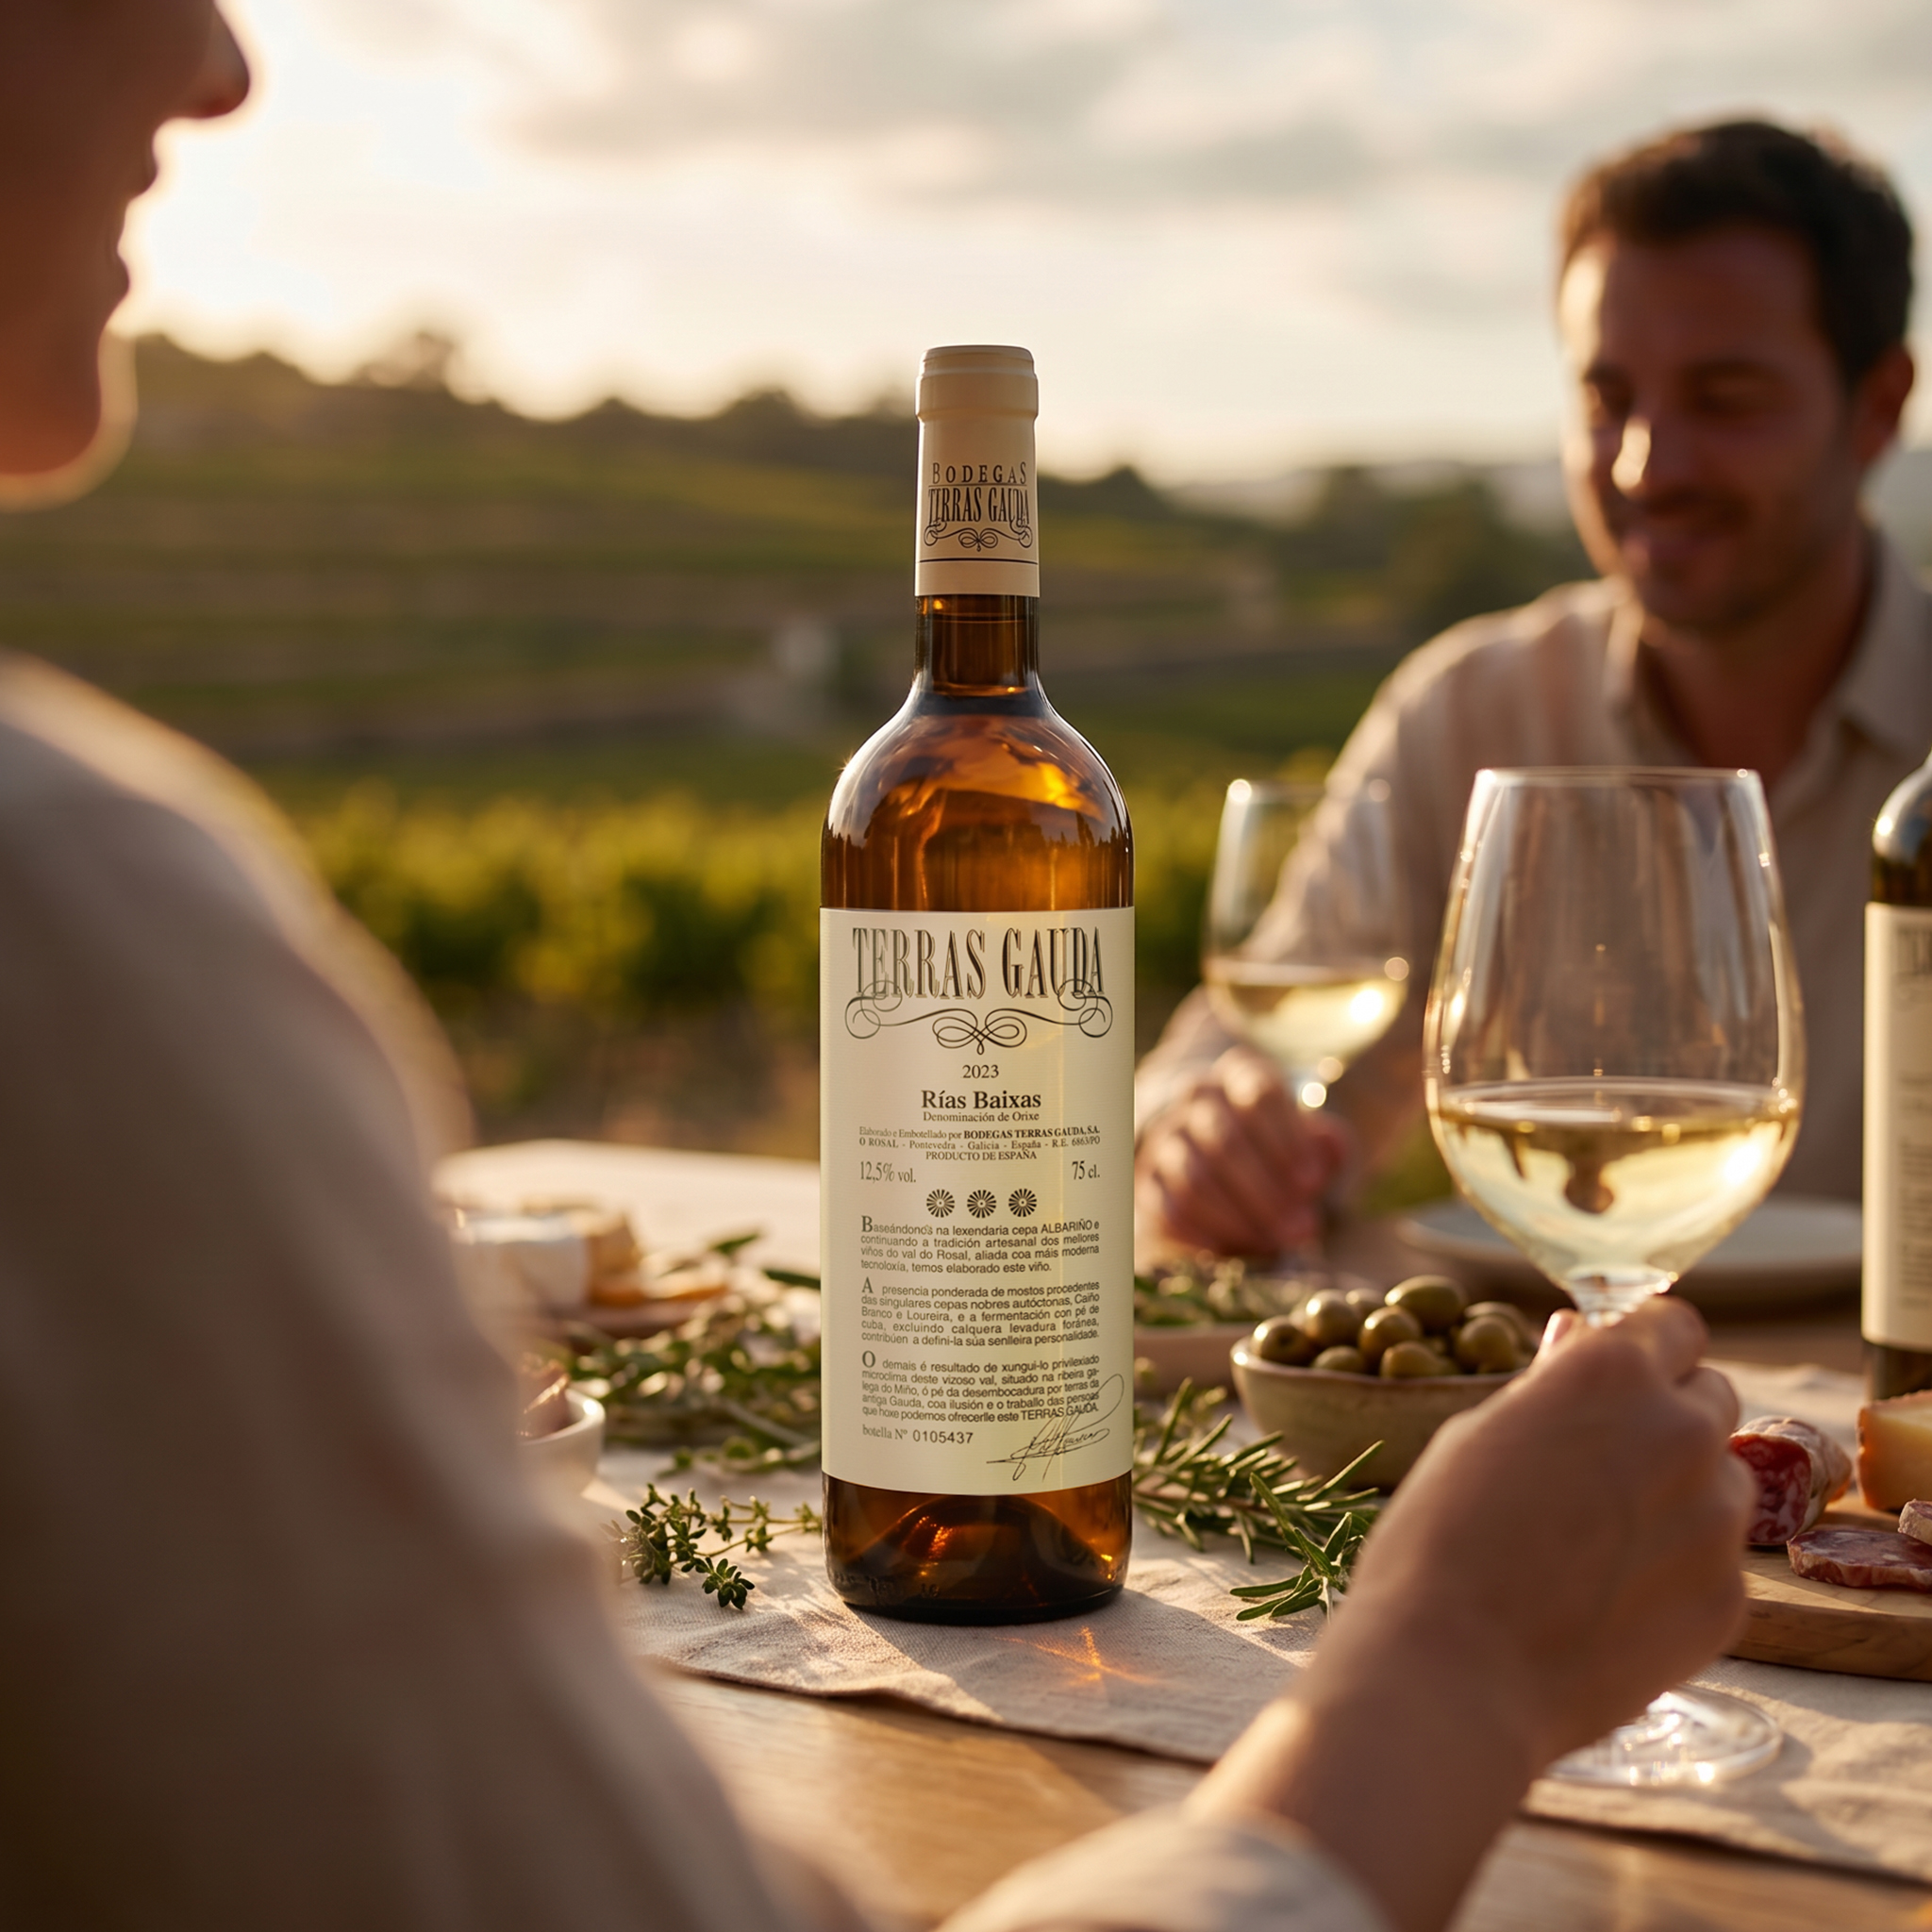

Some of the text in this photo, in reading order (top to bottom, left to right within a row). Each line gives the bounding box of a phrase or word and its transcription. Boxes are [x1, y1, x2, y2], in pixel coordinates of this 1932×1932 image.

[932, 461, 1026, 484] BODEGAS
[988, 487, 1030, 525] GAUDA
[852, 925, 1105, 1000] TERRAS GAUDA
[962, 1064, 999, 1079] 2023
[921, 1090, 1041, 1108] Rías Baixas
[923, 1111, 1040, 1122] Denominación de Orixe
[859, 1126, 891, 1137] Elaborado
[898, 1129, 947, 1139] Embotellado
[948, 1132, 961, 1141] por
[963, 1130, 1013, 1139] BODEGAS
[1014, 1128, 1053, 1138] TERRAS
[859, 1137, 866, 1146] O
[868, 1138, 898, 1148] ROSAL
[909, 1140, 956, 1150] Pontevedra
[967, 1141, 999, 1150] Galicia
[1011, 1140, 1041, 1151] España
[1052, 1138, 1069, 1147] R.E.
[1072, 1135, 1101, 1147] 6863/PO
[925, 1148, 1037, 1160] PRODUCTO DE ESPAÑA
[860, 1160, 917, 1183] 12,5% vol.
[1072, 1160, 1100, 1180] 75 cl.
[936, 1227, 949, 1236] na
[953, 1225, 1008, 1236] lexendaria
[1011, 1226, 1038, 1237] cepa
[1041, 1219, 1092, 1234] ALBARIÑO
[1093, 1221, 1100, 1229] e
[860, 1233, 1100, 1248] continuando a tradición artesanal dos mellores
[860, 1245, 1100, 1261] viños do val do Rosal, aliada coa máis moderna
[860, 1259, 1052, 1274] tecnoloxía, temos elaborado este viño.
[861, 1275, 1100, 1299] A presencia ponderada de mostos procedentes
[861, 1292, 1100, 1311] das singulares cepas nobres autóctonas, Caiño
[861, 1305, 1100, 1323] Branco e Loureira, e a fermentación con pé de
[861, 1318, 1100, 1336] cuba, excluindo calquera levadura foránea,
[861, 1329, 1100, 1346] contribúen a defini-la súa senlleira personalidade.
[861, 1350, 1100, 1374] O demais é resultado de xungui-lo privilexiado
[861, 1368, 1100, 1386] microclima deste vizoso val, situado na ribeira ga-
[861, 1378, 1100, 1398] lega do Miño, ó pé da desembocadura por terras da
[861, 1391, 1100, 1410] antiga Gauda, coa ilusión e o traballo das persoas
[861, 1407, 878, 1417] que
[878, 1407, 899, 1419] hoxe
[901, 1409, 946, 1422] podemos
[947, 1411, 995, 1423] ofrecerlle
[997, 1411, 1020, 1422] este
[1021, 1407, 1065, 1421] TERRAS
[862, 1424, 892, 1440] botella
[912, 1429, 974, 1444] 0105437
